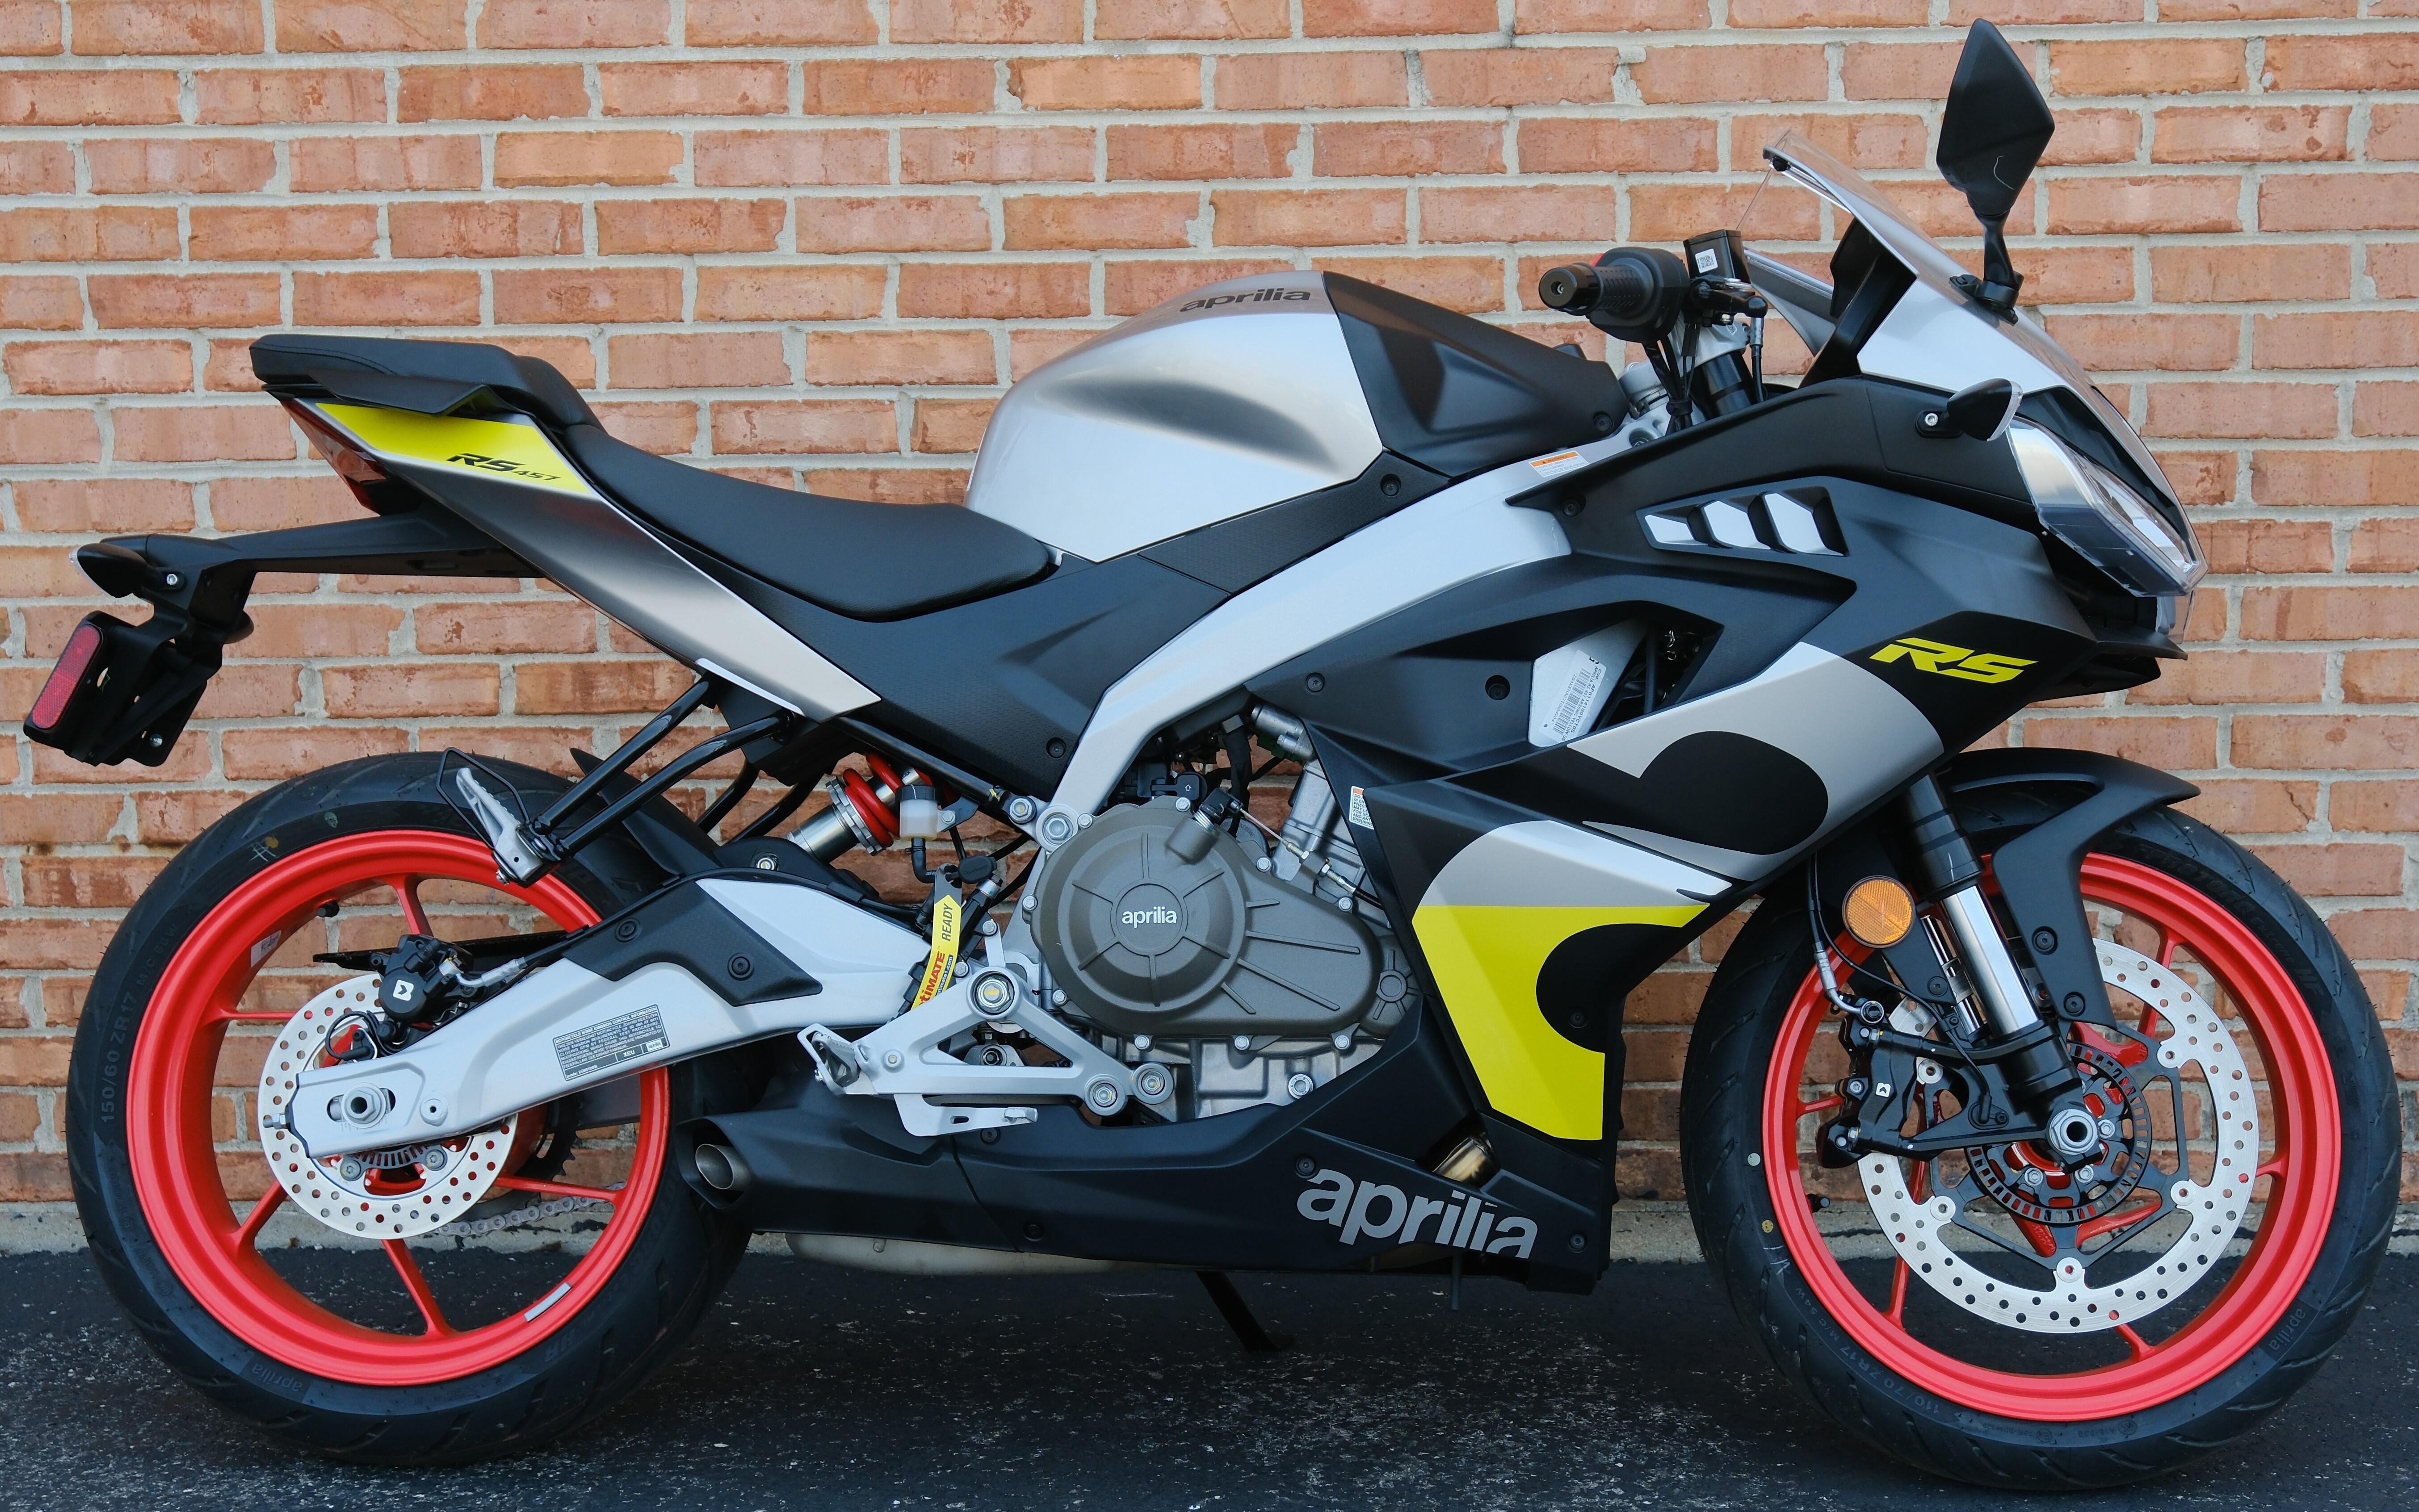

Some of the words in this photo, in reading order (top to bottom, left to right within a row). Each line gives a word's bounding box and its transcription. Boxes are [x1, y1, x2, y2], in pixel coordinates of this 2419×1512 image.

[1180, 288, 1311, 312] aprilia
[446, 453, 526, 471] RS
[510, 470, 561, 480] 457
[1869, 637, 2039, 684] RS
[941, 903, 953, 942] READY
[1122, 906, 1177, 928] aprilia
[919, 951, 945, 1005] tiMATE
[937, 955, 953, 995] ptimate1.com
[99, 1047, 122, 1123] 150/60
[133, 955, 158, 988] M/C
[555, 1031, 581, 1043] MOTORCYCLE
[612, 1015, 630, 1025] CONTROL
[622, 1049, 635, 1057] XEU
[1297, 1169, 1538, 1259] aprilia
[2265, 1305, 2311, 1355] aprilia
[248, 1359, 304, 1398] aprilia
[1880, 1374, 1943, 1415] 110/70
